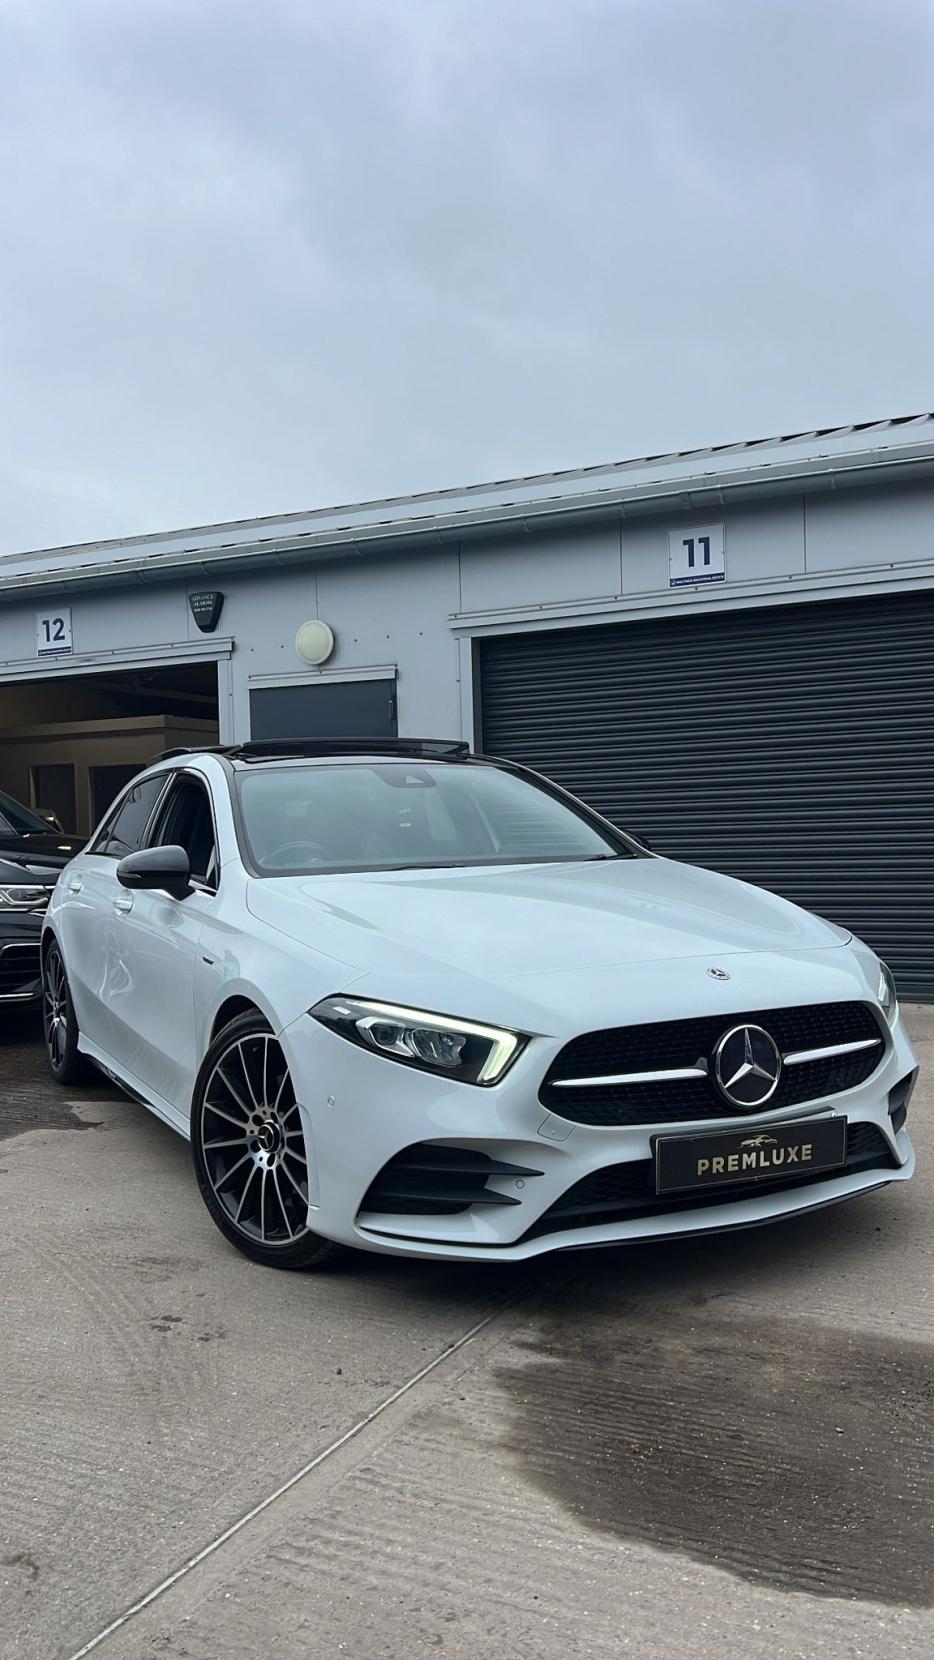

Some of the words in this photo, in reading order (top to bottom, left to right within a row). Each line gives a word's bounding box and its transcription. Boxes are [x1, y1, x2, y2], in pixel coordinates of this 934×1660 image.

[682, 536, 711, 568] 11
[42, 617, 66, 642] 12
[697, 1144, 813, 1176] PREMLUXE
